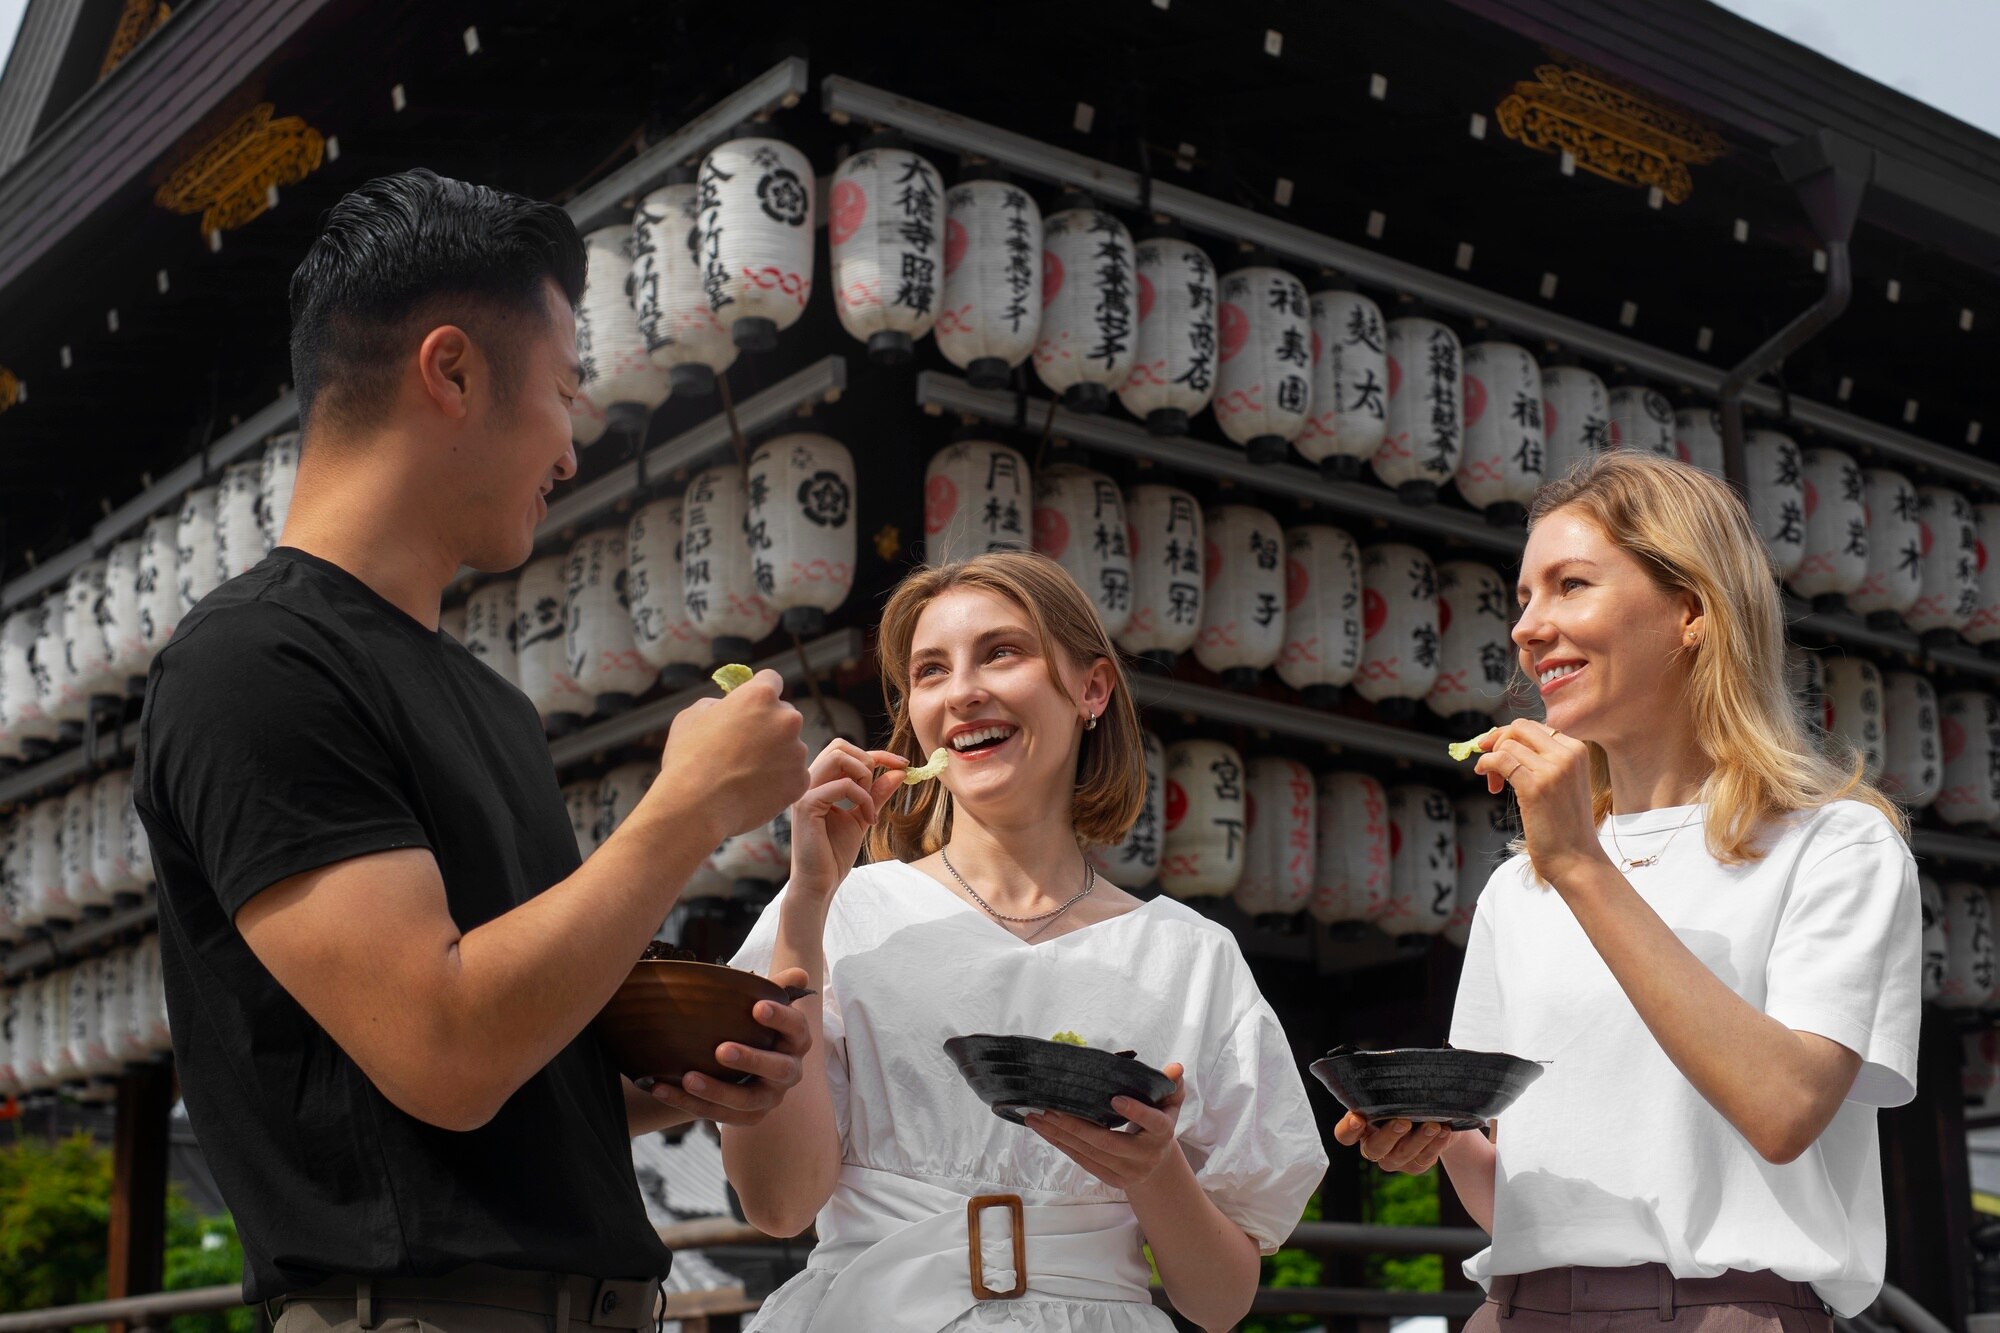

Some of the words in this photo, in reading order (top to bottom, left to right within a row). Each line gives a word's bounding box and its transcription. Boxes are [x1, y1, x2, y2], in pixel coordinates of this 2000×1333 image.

[1094, 480, 1130, 612] 月桂冠
[1162, 495, 1200, 626] 月桂冠
[1210, 754, 1242, 861] 宮下
